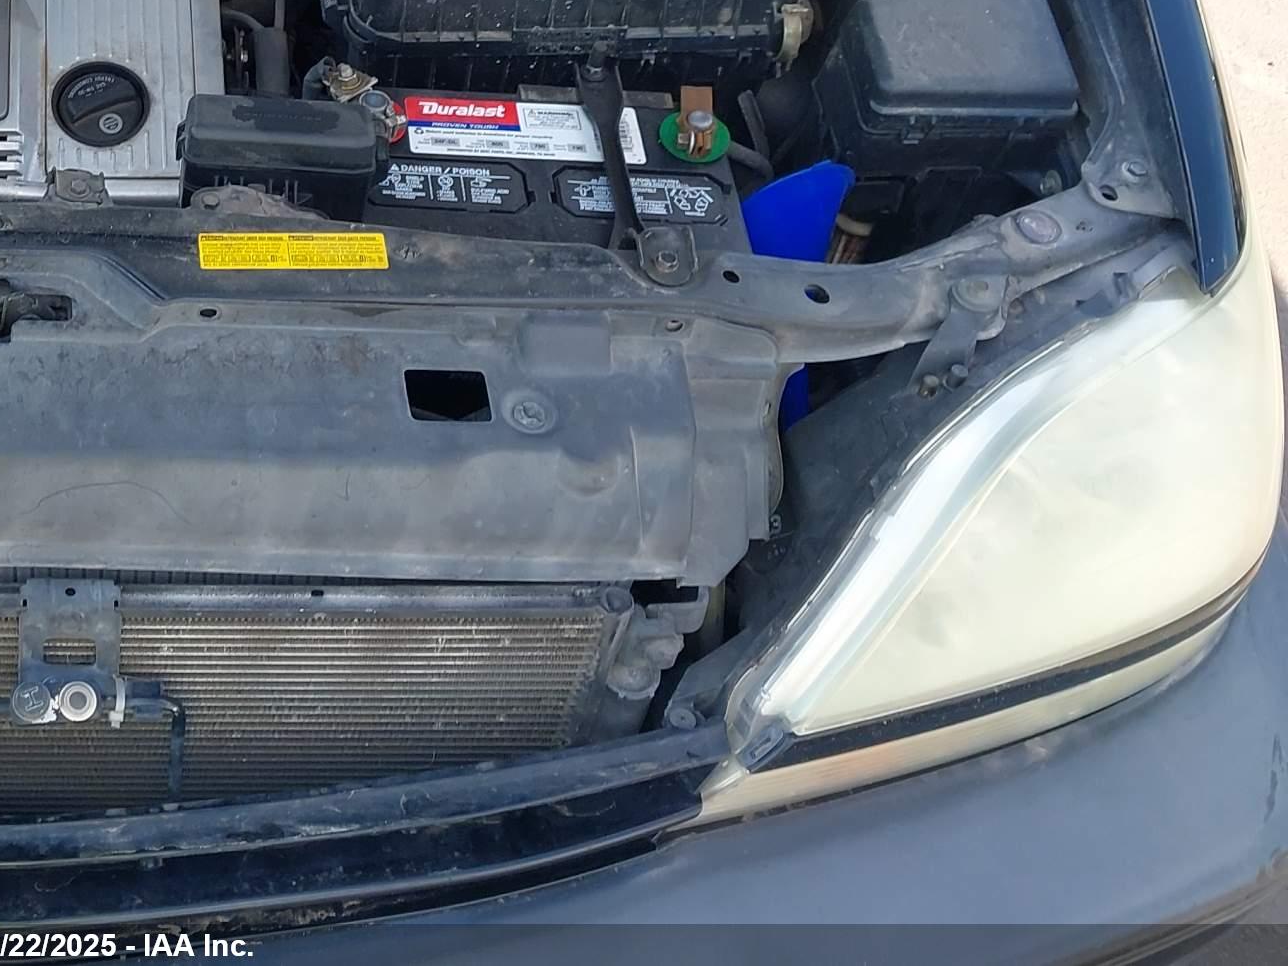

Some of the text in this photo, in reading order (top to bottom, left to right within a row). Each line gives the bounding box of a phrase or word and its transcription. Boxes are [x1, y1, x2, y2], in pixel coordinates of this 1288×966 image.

[418, 101, 506, 118] Duralast
[431, 121, 499, 130] PROVEN TOUGH
[400, 166, 442, 175] DANGER
[452, 167, 490, 176] POISON
